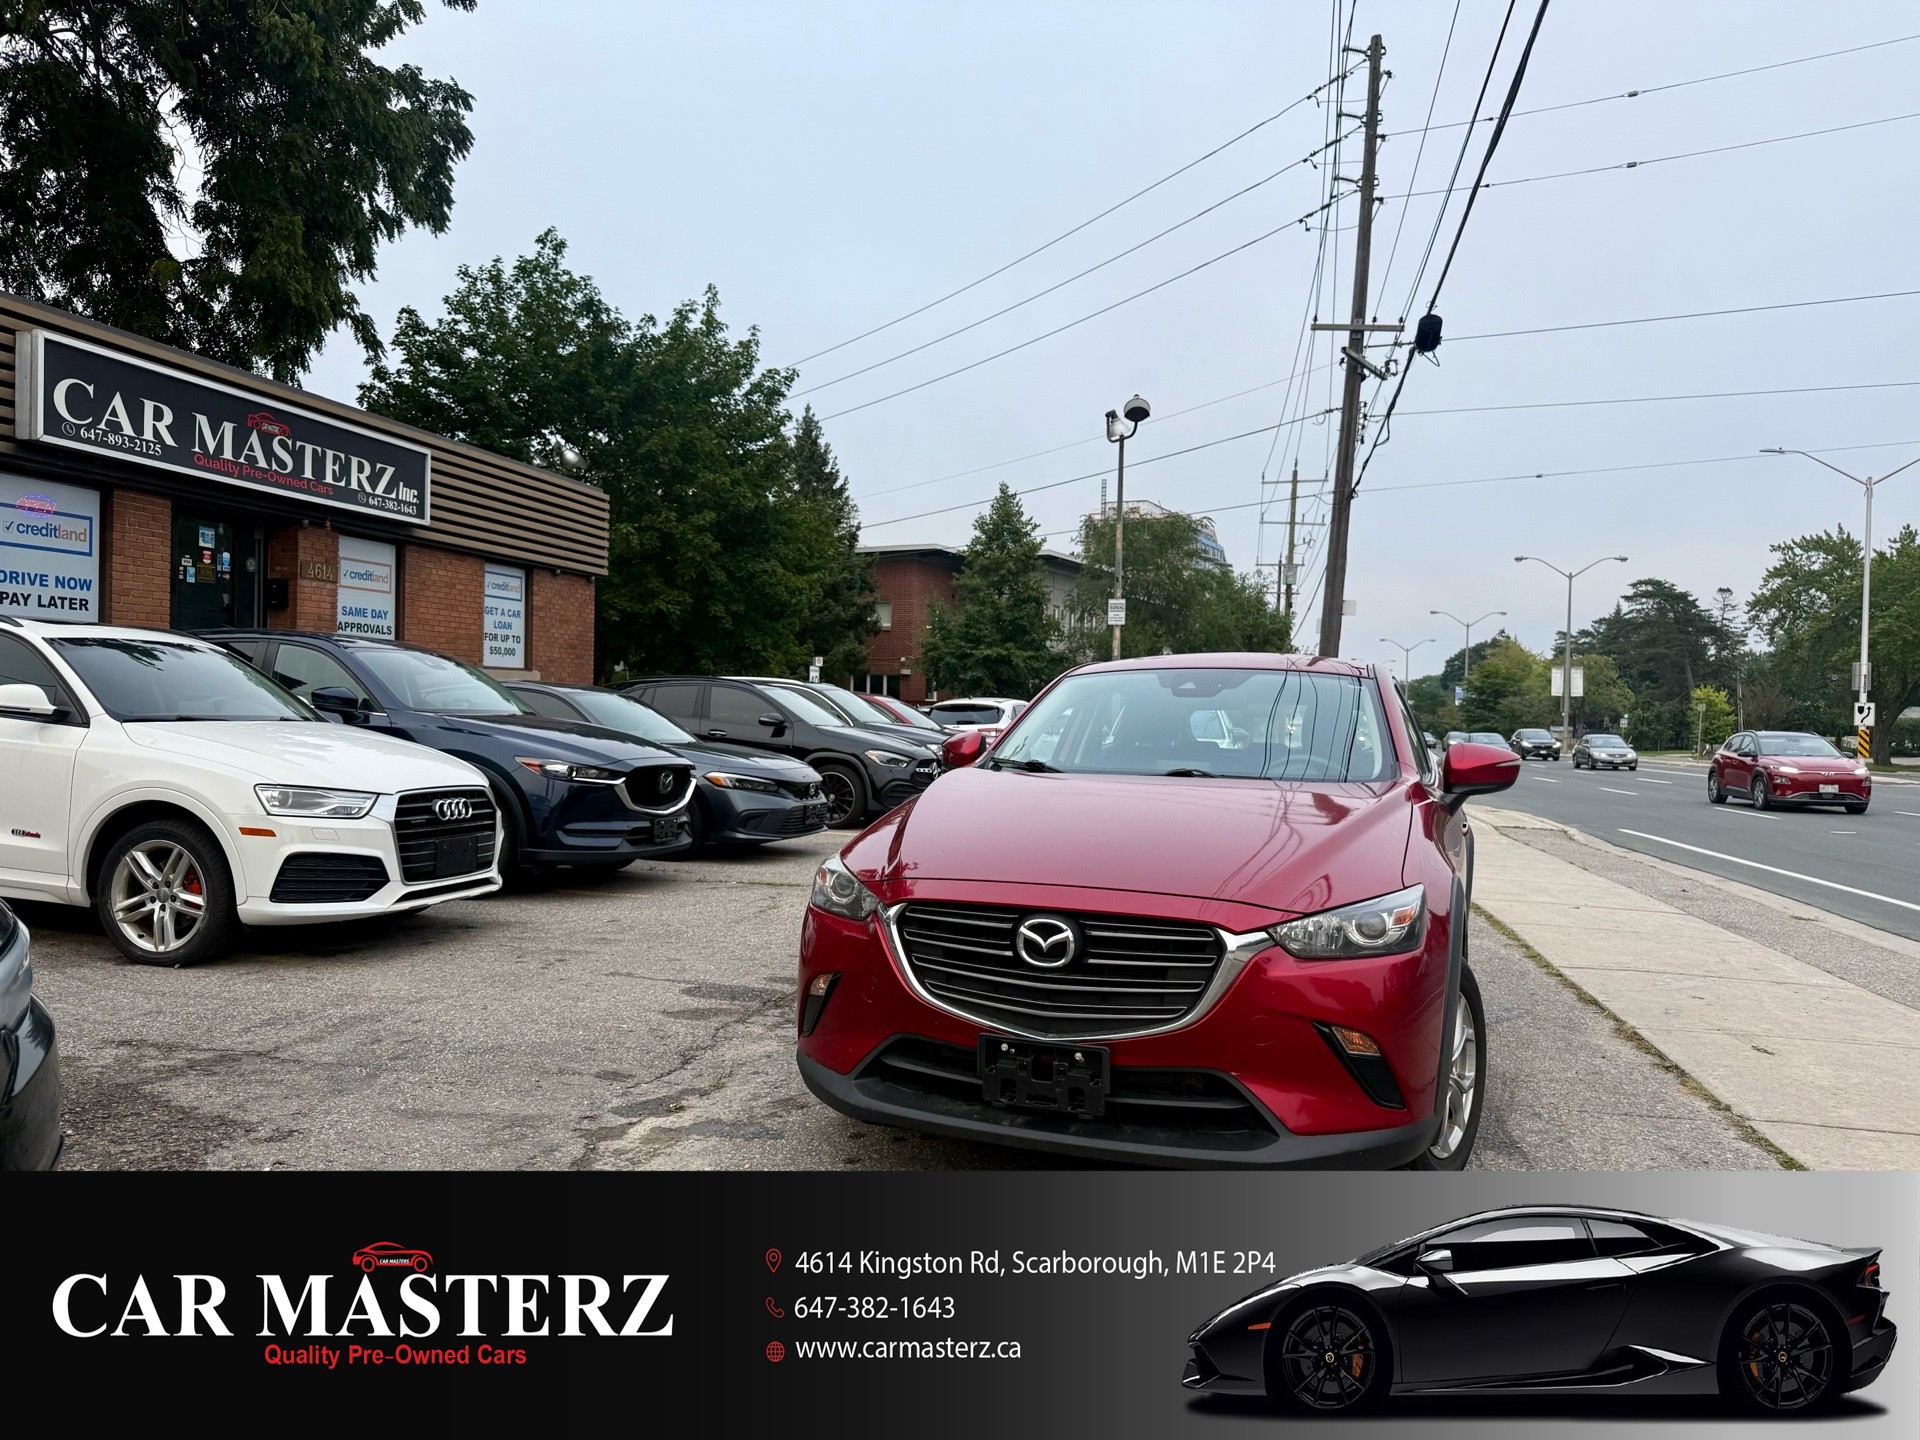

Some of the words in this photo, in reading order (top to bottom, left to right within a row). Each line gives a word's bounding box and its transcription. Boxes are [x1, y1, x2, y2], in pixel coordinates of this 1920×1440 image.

[53, 378, 178, 447] CAR
[191, 412, 397, 499] MASTERZ
[399, 481, 420, 504] Inc.
[80, 426, 162, 456] 647-893-2125
[193, 453, 239, 478] Quality
[242, 464, 308, 490] Pre-Owned
[309, 481, 334, 496] Cars
[368, 496, 417, 515] 647-382-1643
[16, 522, 87, 543] creditland
[307, 562, 333, 580] 4614
[349, 569, 389, 584] creditland
[0, 569, 49, 588] DRIVE
[54, 575, 93, 592] NOW
[491, 581, 520, 593] creditland
[0, 591, 32, 607] PAY
[37, 594, 90, 612] LATER
[341, 605, 368, 618] SAME
[370, 608, 389, 620] DAY
[484, 606, 499, 616] GET
[500, 608, 506, 617] A
[507, 609, 521, 618] CAR
[337, 621, 393, 635] APPROVALS
[493, 620, 513, 630] LOAN
[484, 632, 499, 642] FOR
[500, 634, 510, 643] UP
[511, 635, 521, 644] TO
[489, 646, 516, 657] $50,000
